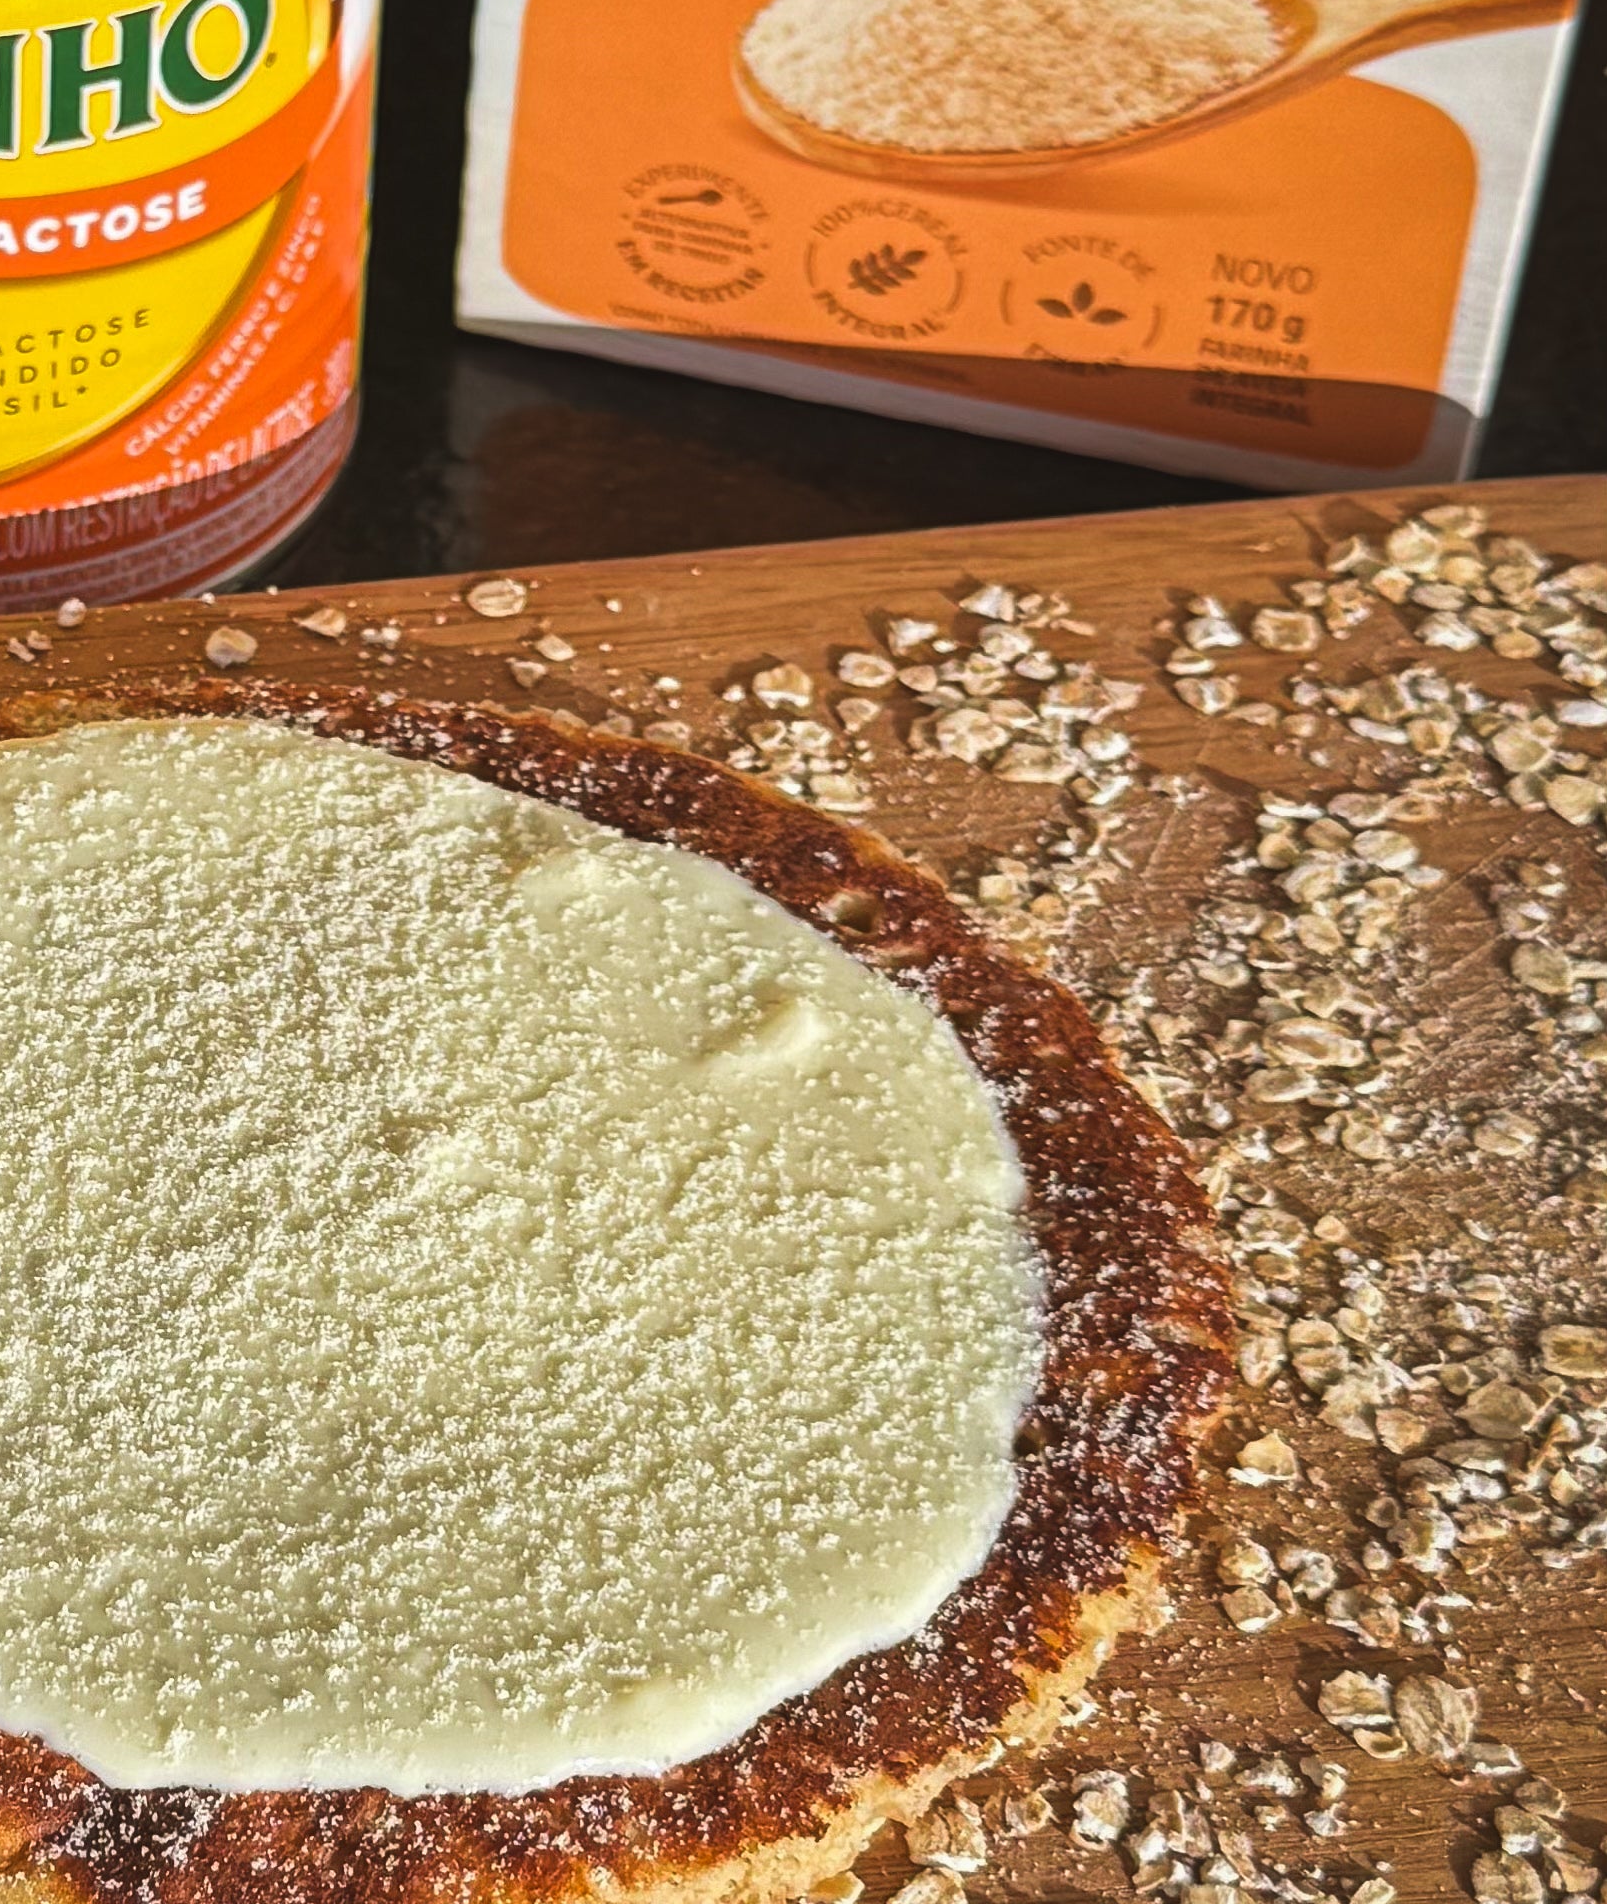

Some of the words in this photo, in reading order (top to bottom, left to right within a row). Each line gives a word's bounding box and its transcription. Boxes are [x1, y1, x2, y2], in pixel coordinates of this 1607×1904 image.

[1210, 252, 1314, 296] NOVO
[1206, 296, 1277, 332] 170
[1281, 315, 1306, 345] g
